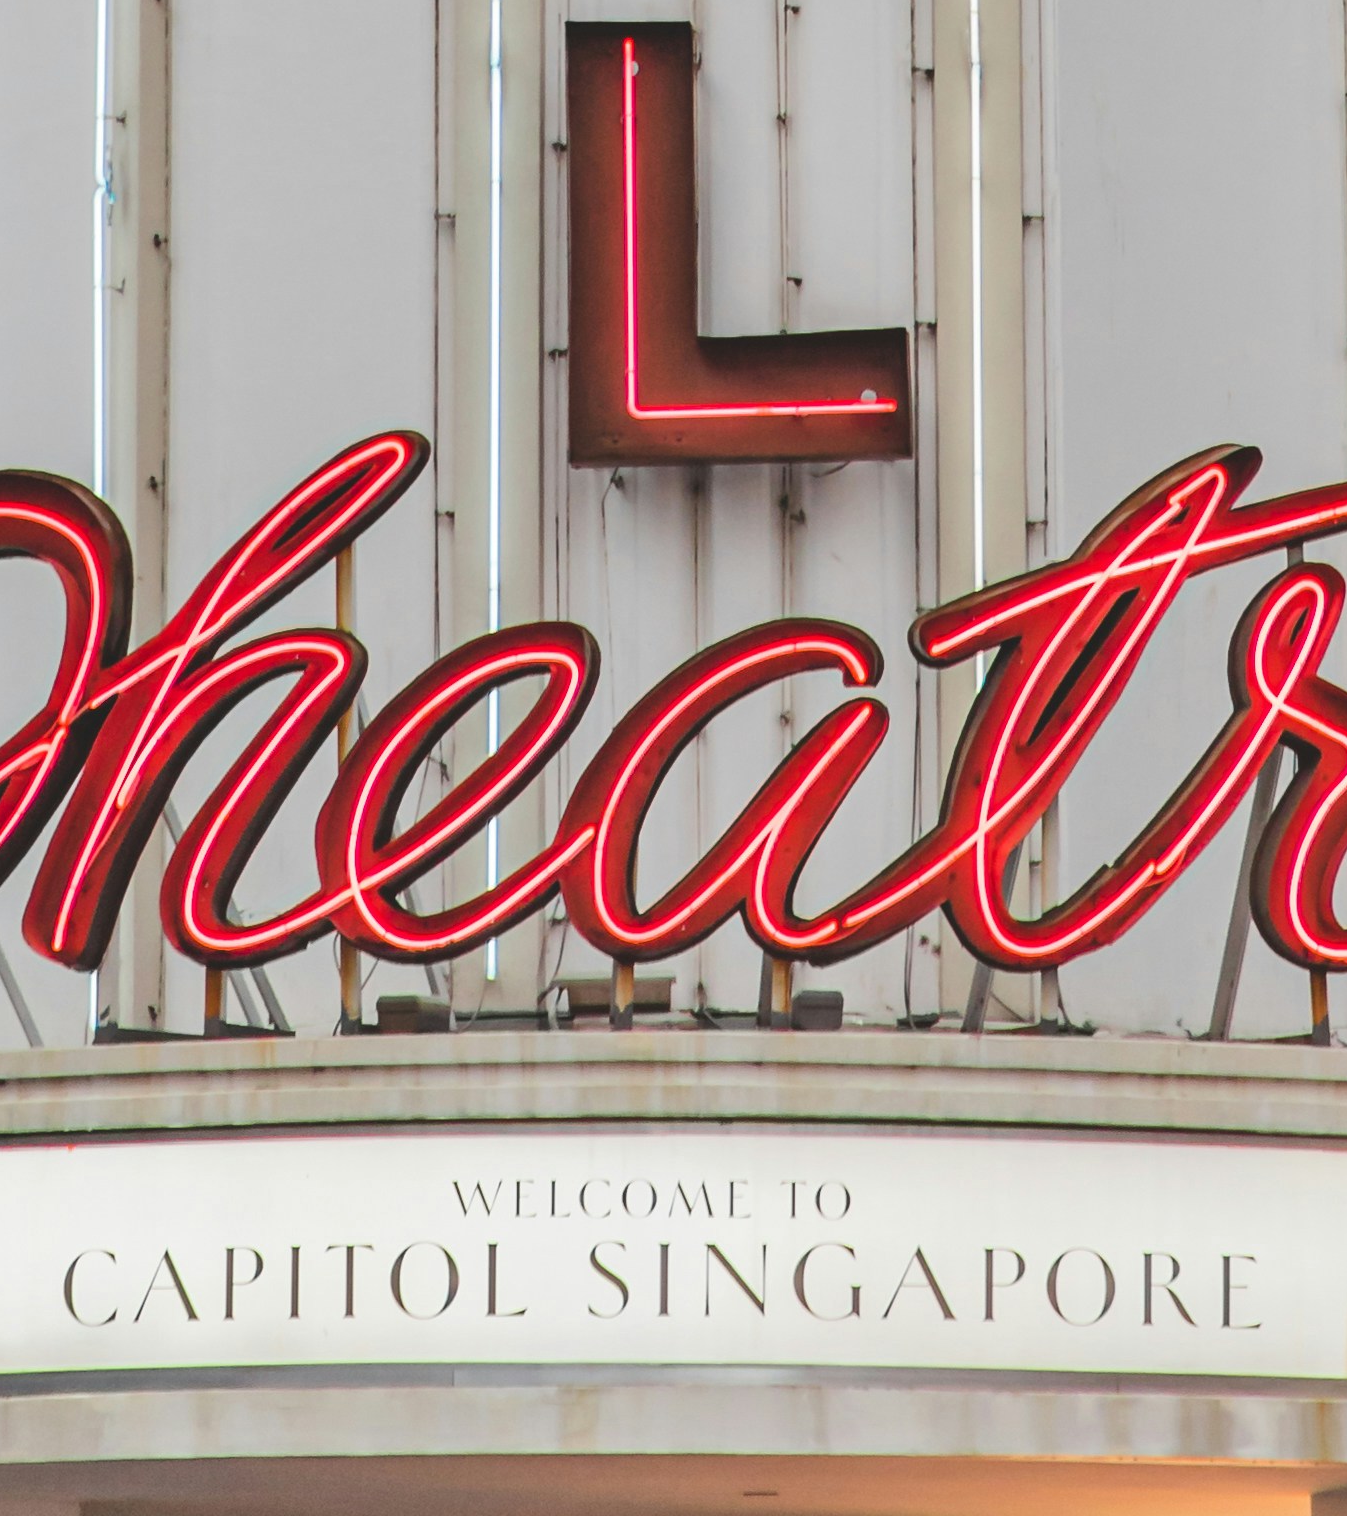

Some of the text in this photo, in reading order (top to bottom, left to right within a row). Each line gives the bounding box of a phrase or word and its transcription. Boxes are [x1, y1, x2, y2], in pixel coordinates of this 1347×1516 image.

[451, 1178, 853, 1222] WELCOME TO
[61, 1239, 1265, 1331] CAPITOL SINGAPORE
